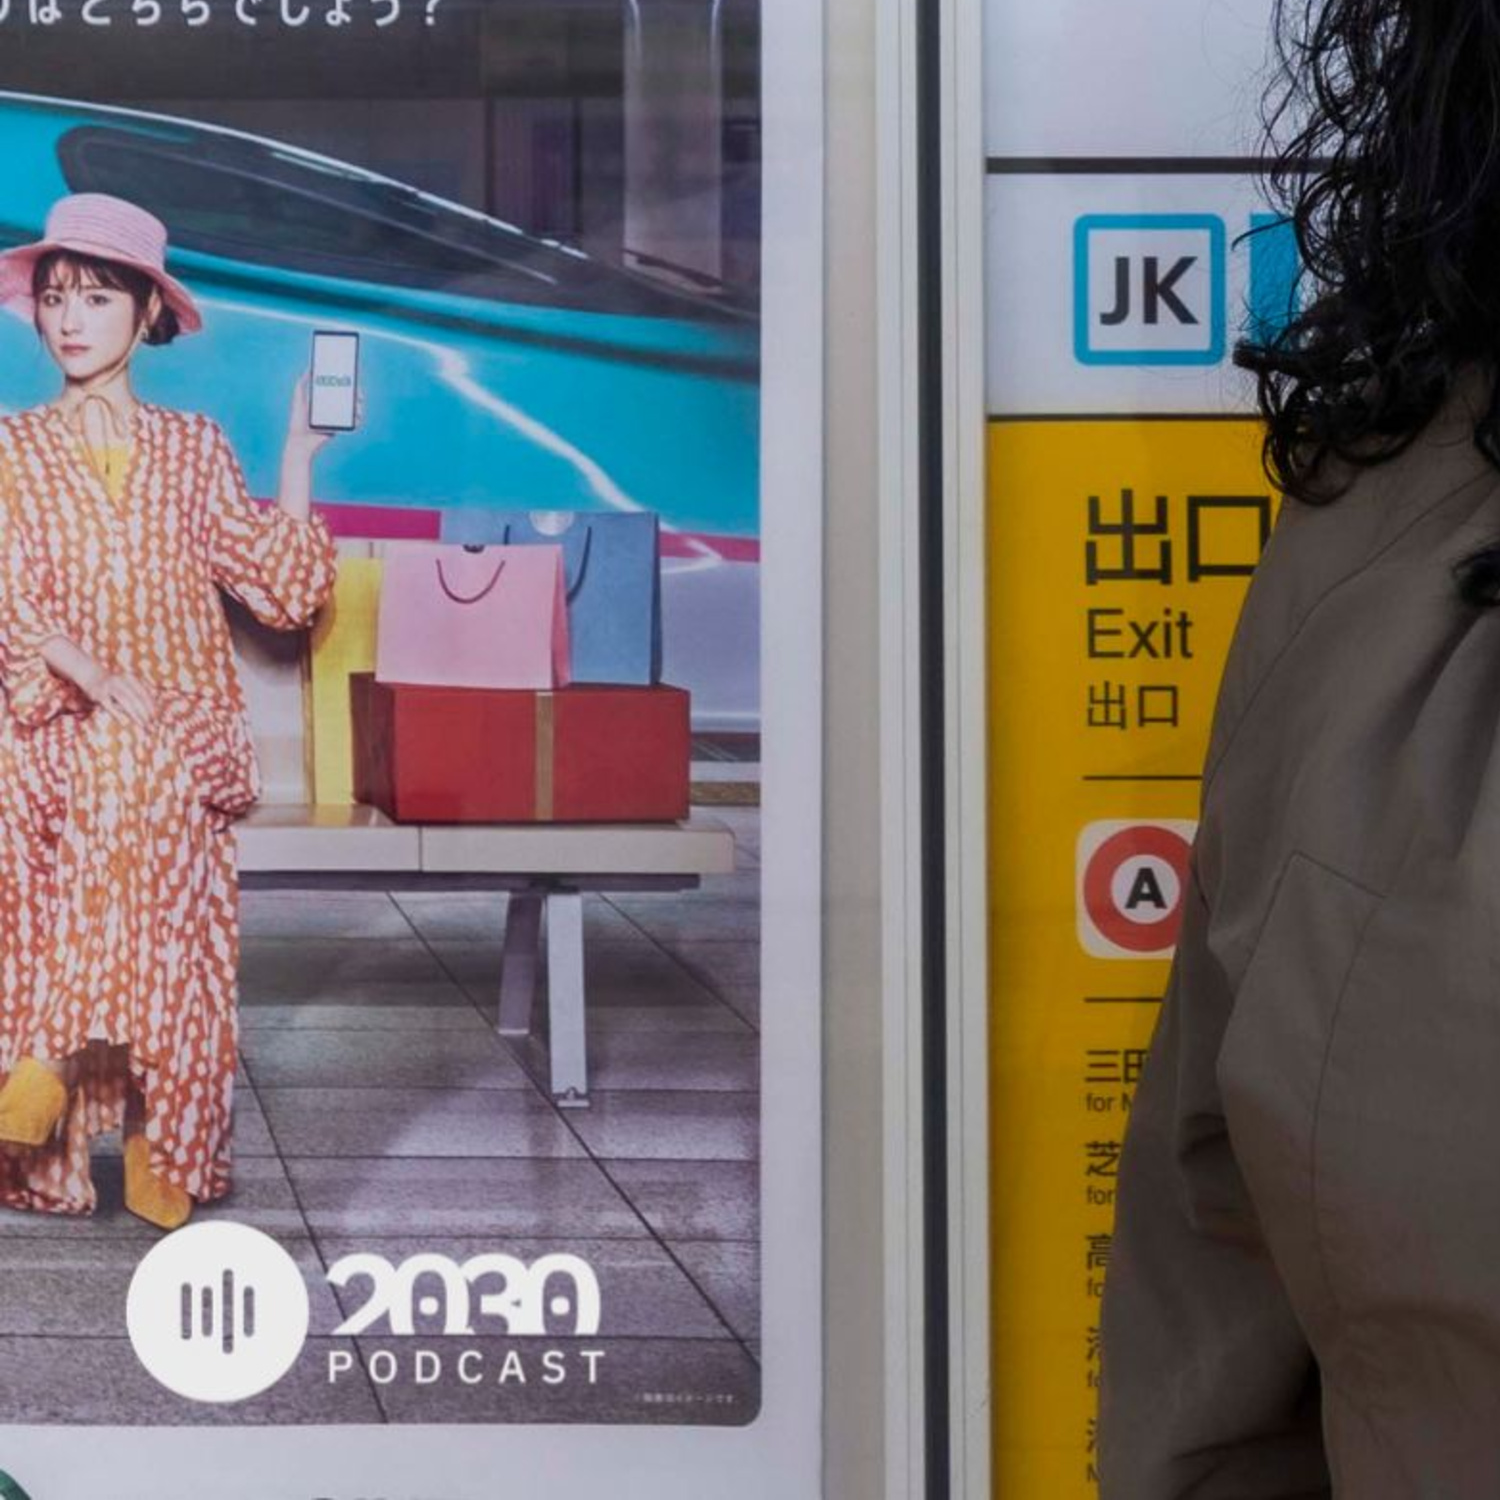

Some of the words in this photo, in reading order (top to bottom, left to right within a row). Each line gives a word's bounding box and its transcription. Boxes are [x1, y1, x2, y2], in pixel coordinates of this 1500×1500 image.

[1100, 256, 1199, 326] JK
[1085, 489, 1271, 585] 出口
[1087, 608, 1193, 659] Exit
[1087, 681, 1178, 730] 出口
[1125, 867, 1168, 909] A
[1087, 1093, 1114, 1112] for
